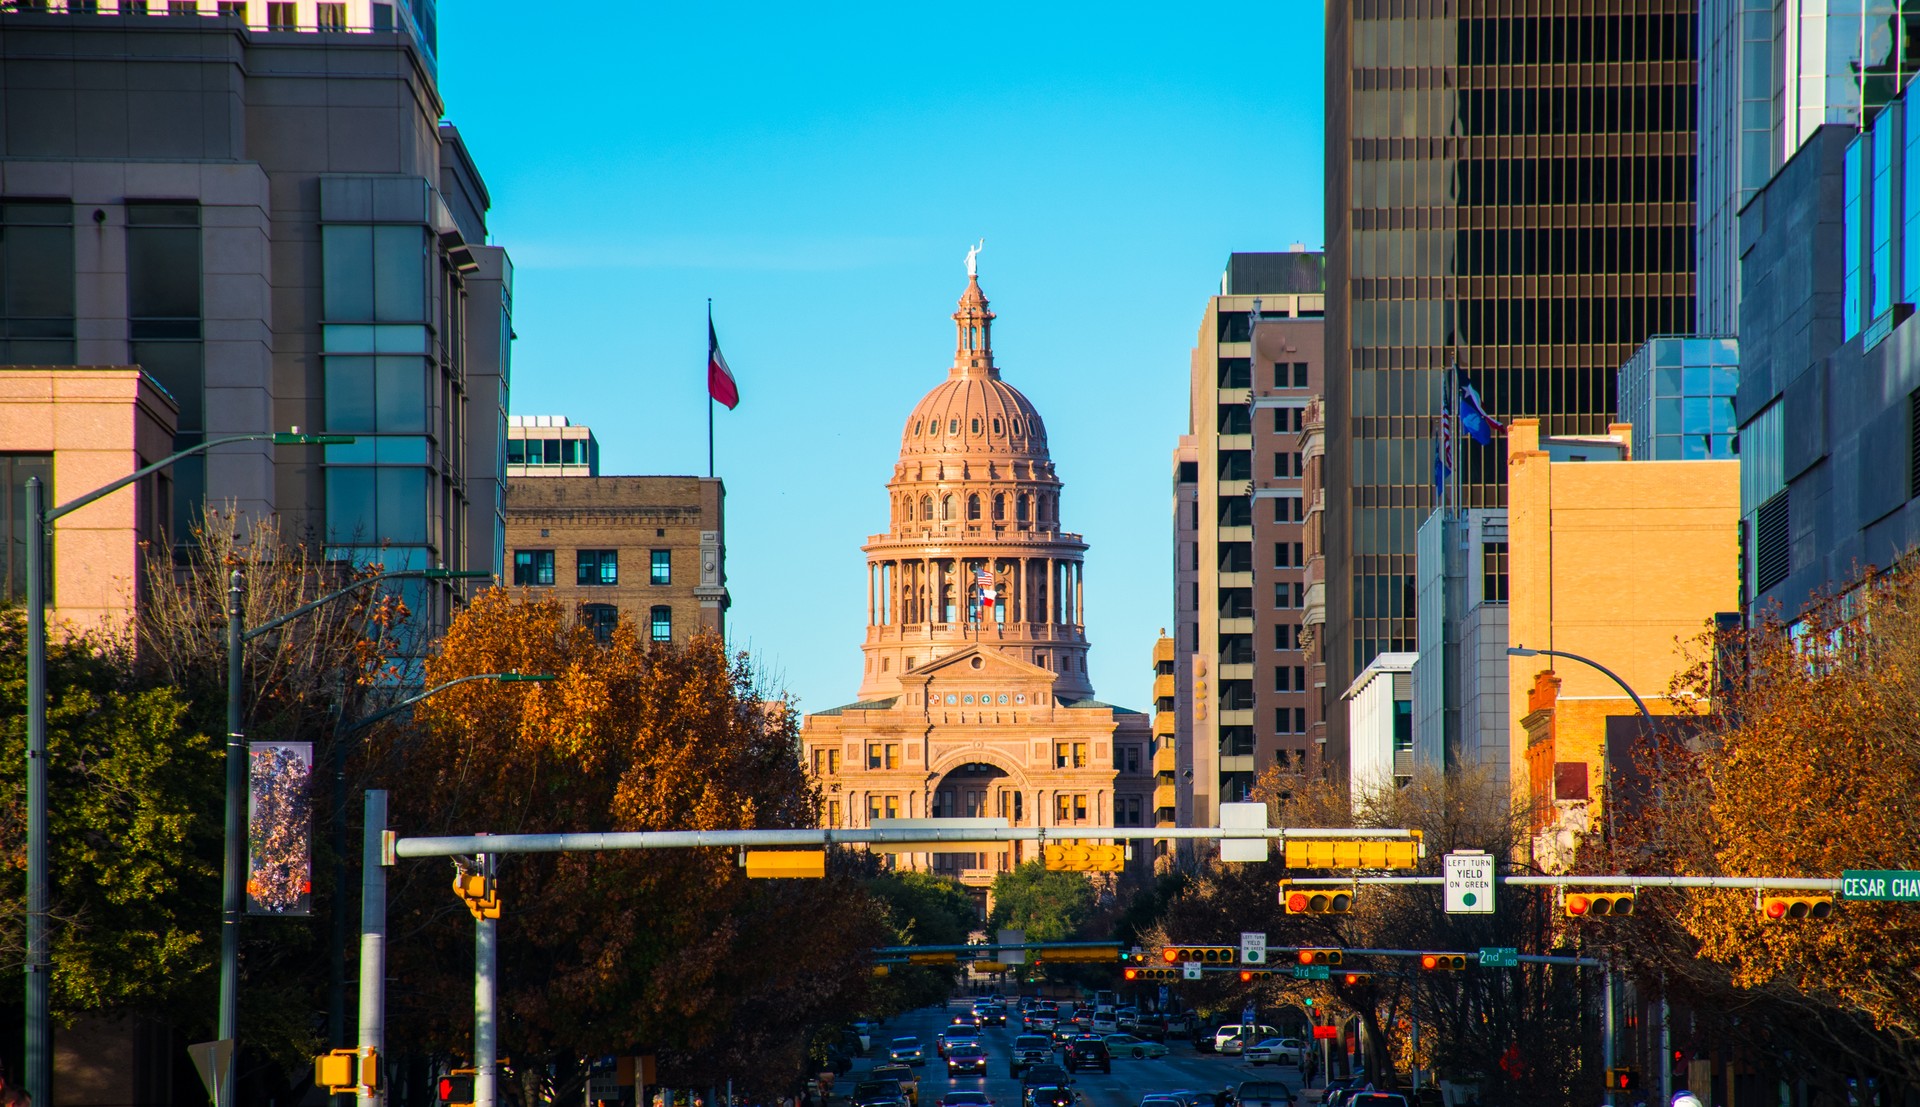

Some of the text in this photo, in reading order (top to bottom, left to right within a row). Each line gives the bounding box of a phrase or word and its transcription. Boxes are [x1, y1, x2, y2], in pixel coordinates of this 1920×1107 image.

[1458, 870, 1482, 878] YIELD
[1844, 878, 1886, 896] CESAR
[1480, 950, 1498, 964] 2nd
[1294, 966, 1308, 976] 3rd
